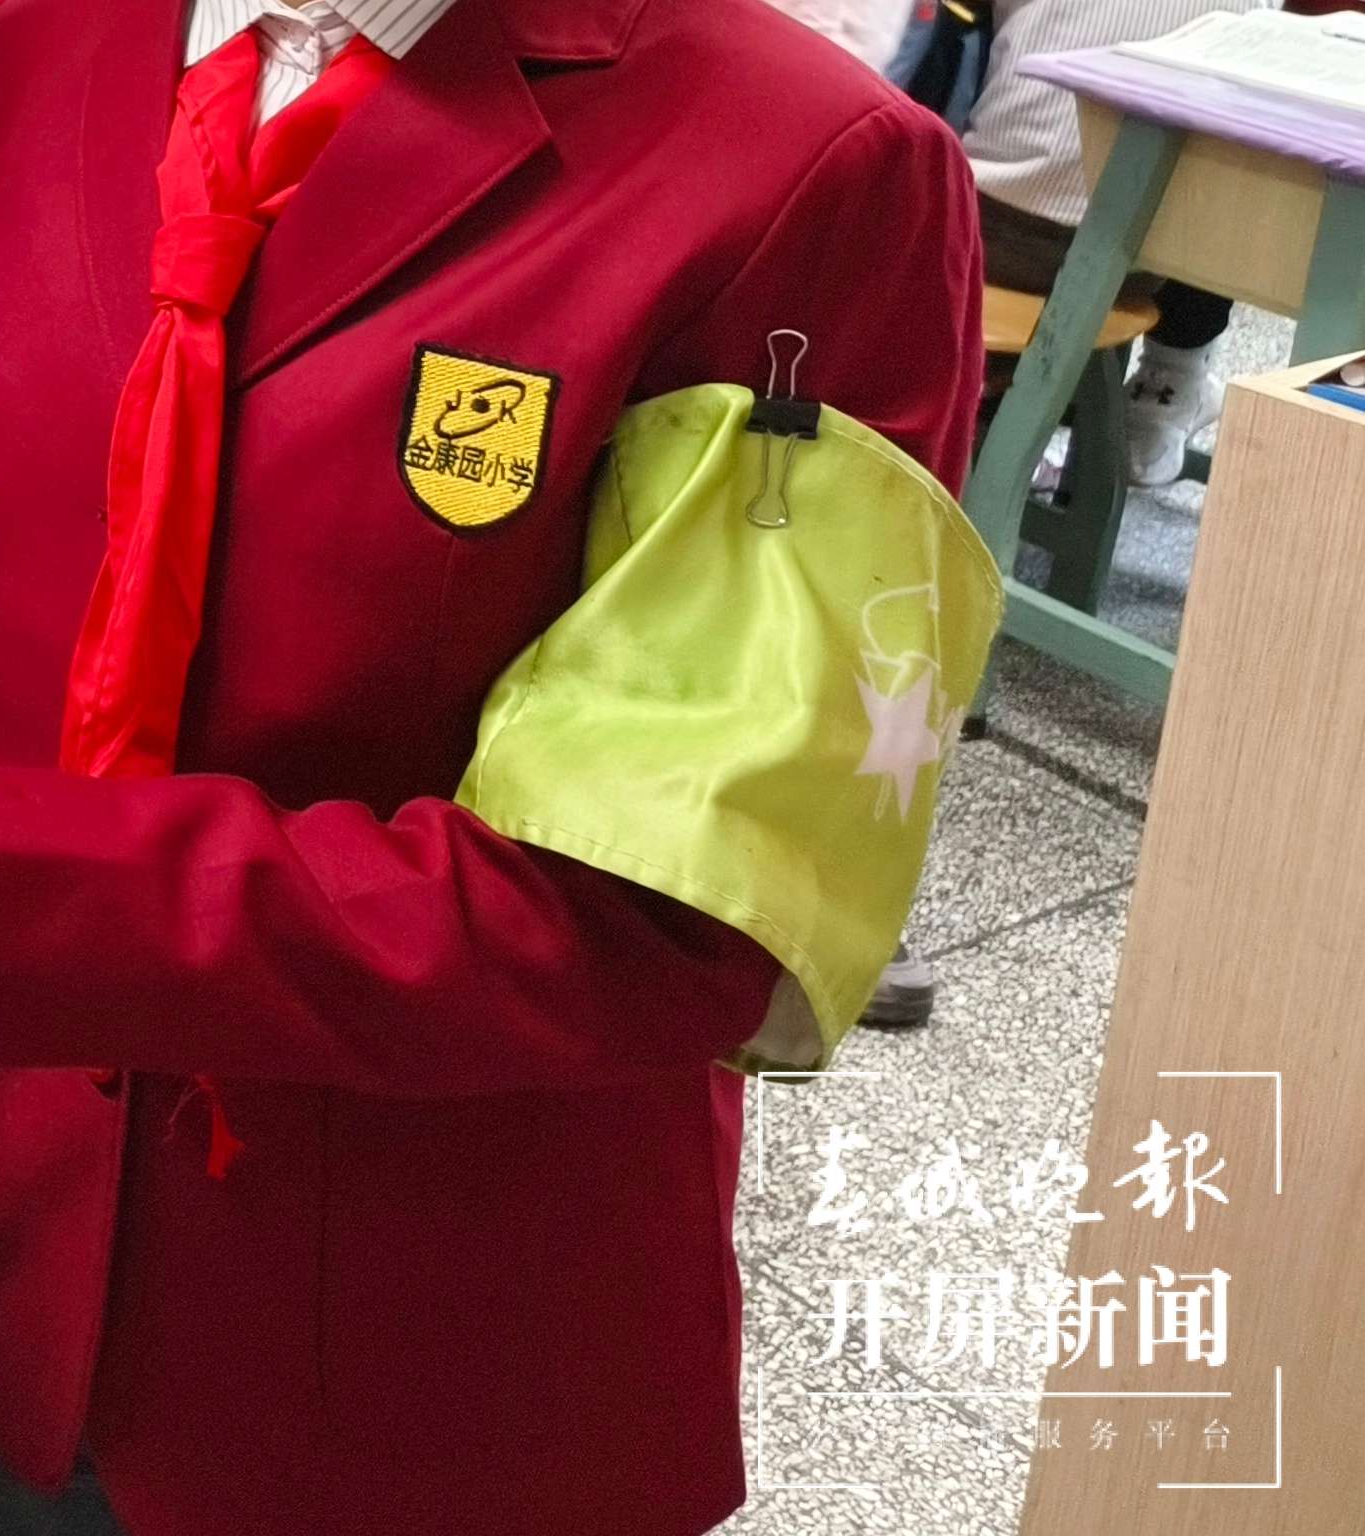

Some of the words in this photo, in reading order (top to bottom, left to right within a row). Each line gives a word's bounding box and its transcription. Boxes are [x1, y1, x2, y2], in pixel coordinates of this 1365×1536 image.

[404, 435, 535, 494] 金康园小学
